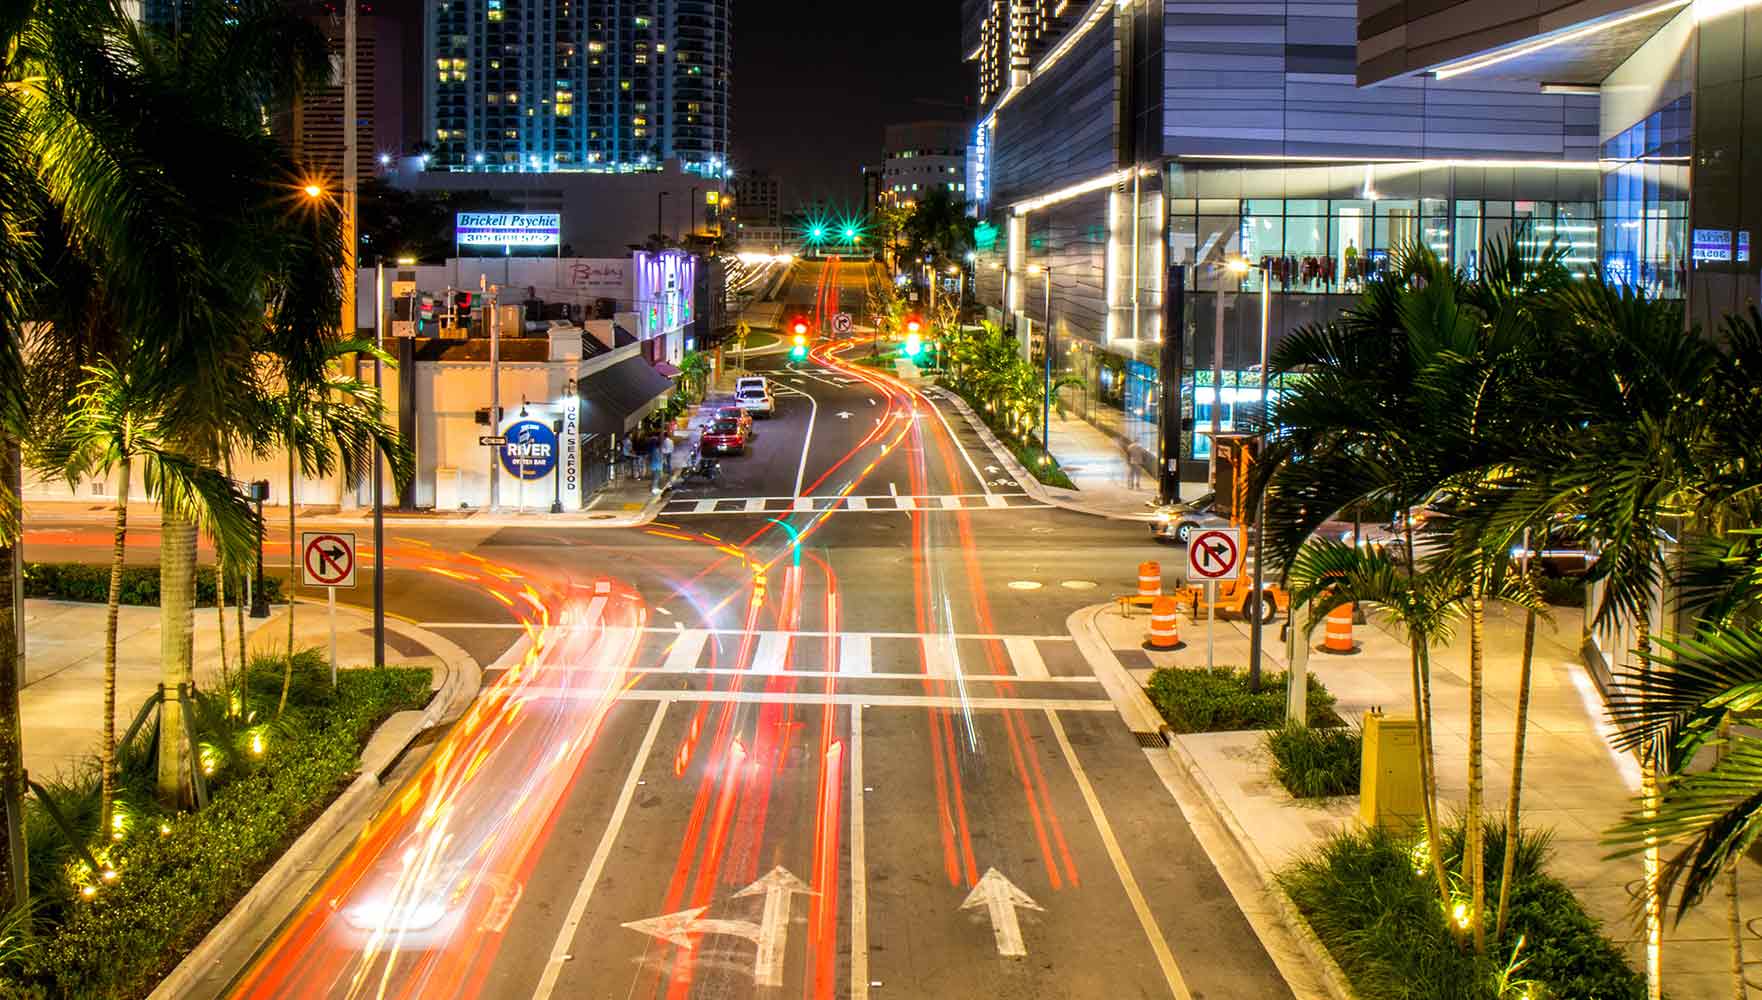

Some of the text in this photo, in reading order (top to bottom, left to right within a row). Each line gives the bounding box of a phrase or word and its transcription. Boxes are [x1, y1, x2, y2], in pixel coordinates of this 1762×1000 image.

[460, 215, 557, 228] Brickell Psychic
[507, 443, 551, 457] RIVER
[567, 398, 576, 490] OCAL SEAFOOD
